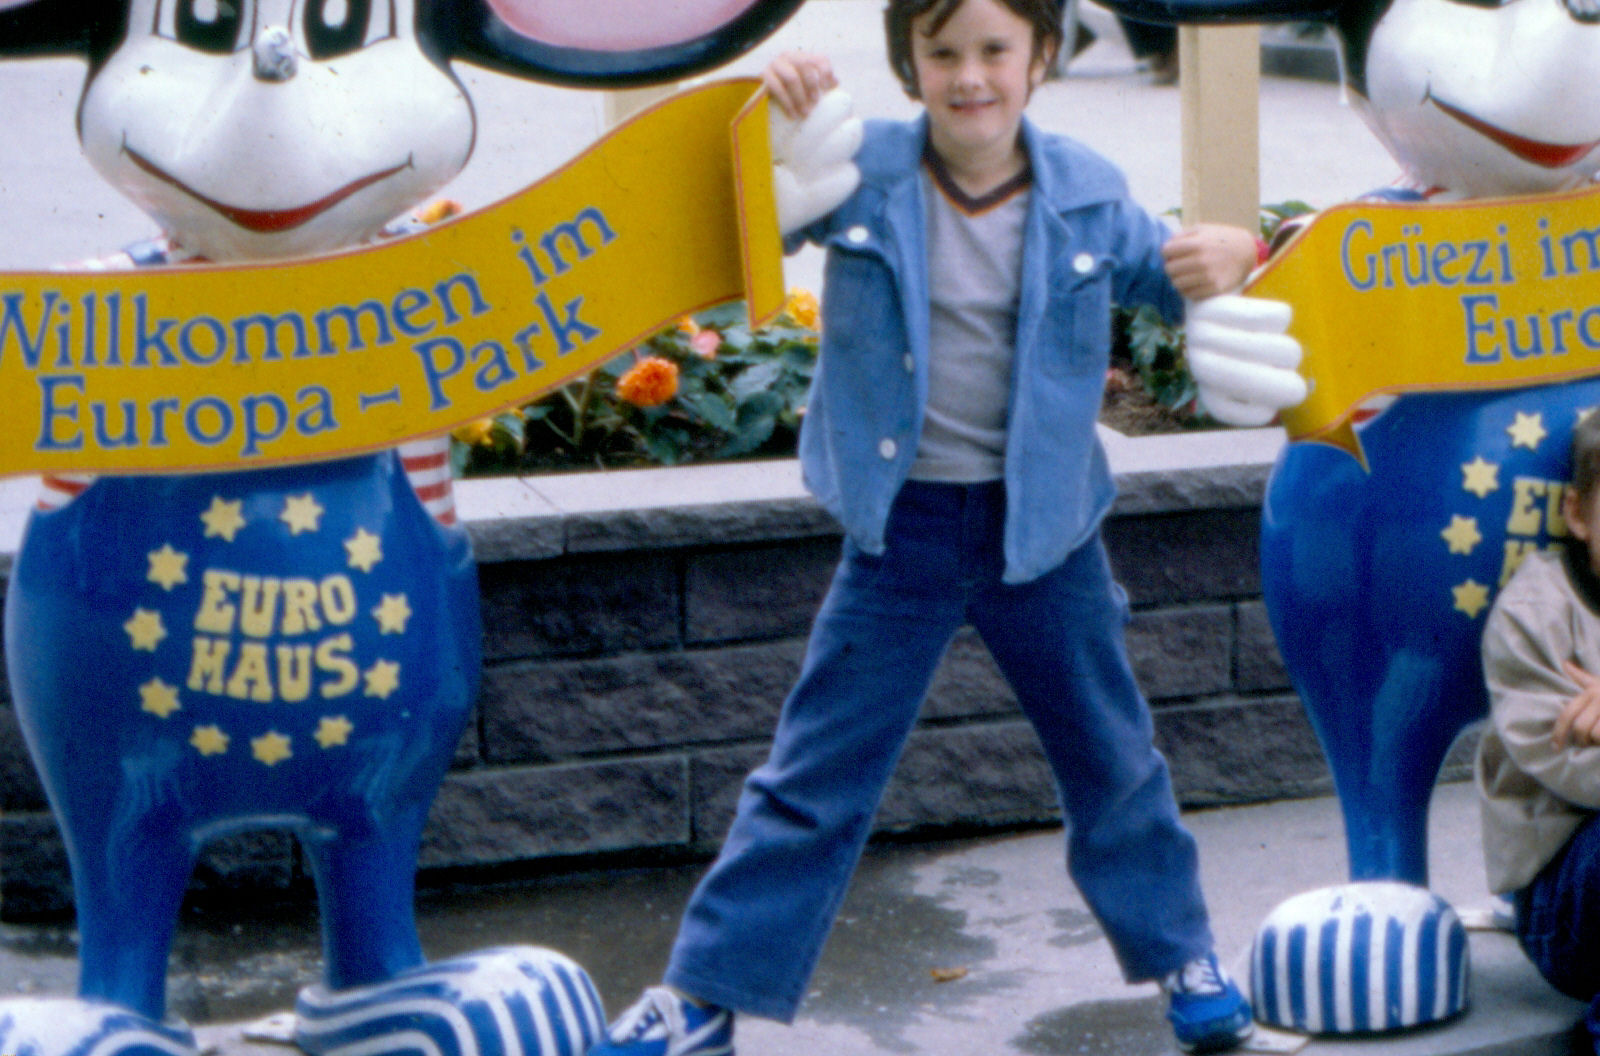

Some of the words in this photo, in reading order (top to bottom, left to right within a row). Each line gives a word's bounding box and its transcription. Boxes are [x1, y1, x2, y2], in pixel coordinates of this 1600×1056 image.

[0, 271, 491, 370] Willkommen
[510, 205, 618, 287] im
[1341, 219, 1516, 292] Grüezi
[34, 374, 339, 457] Europa
[412, 290, 602, 412] Park
[193, 568, 357, 638] EURO
[187, 632, 359, 703] HAUS
